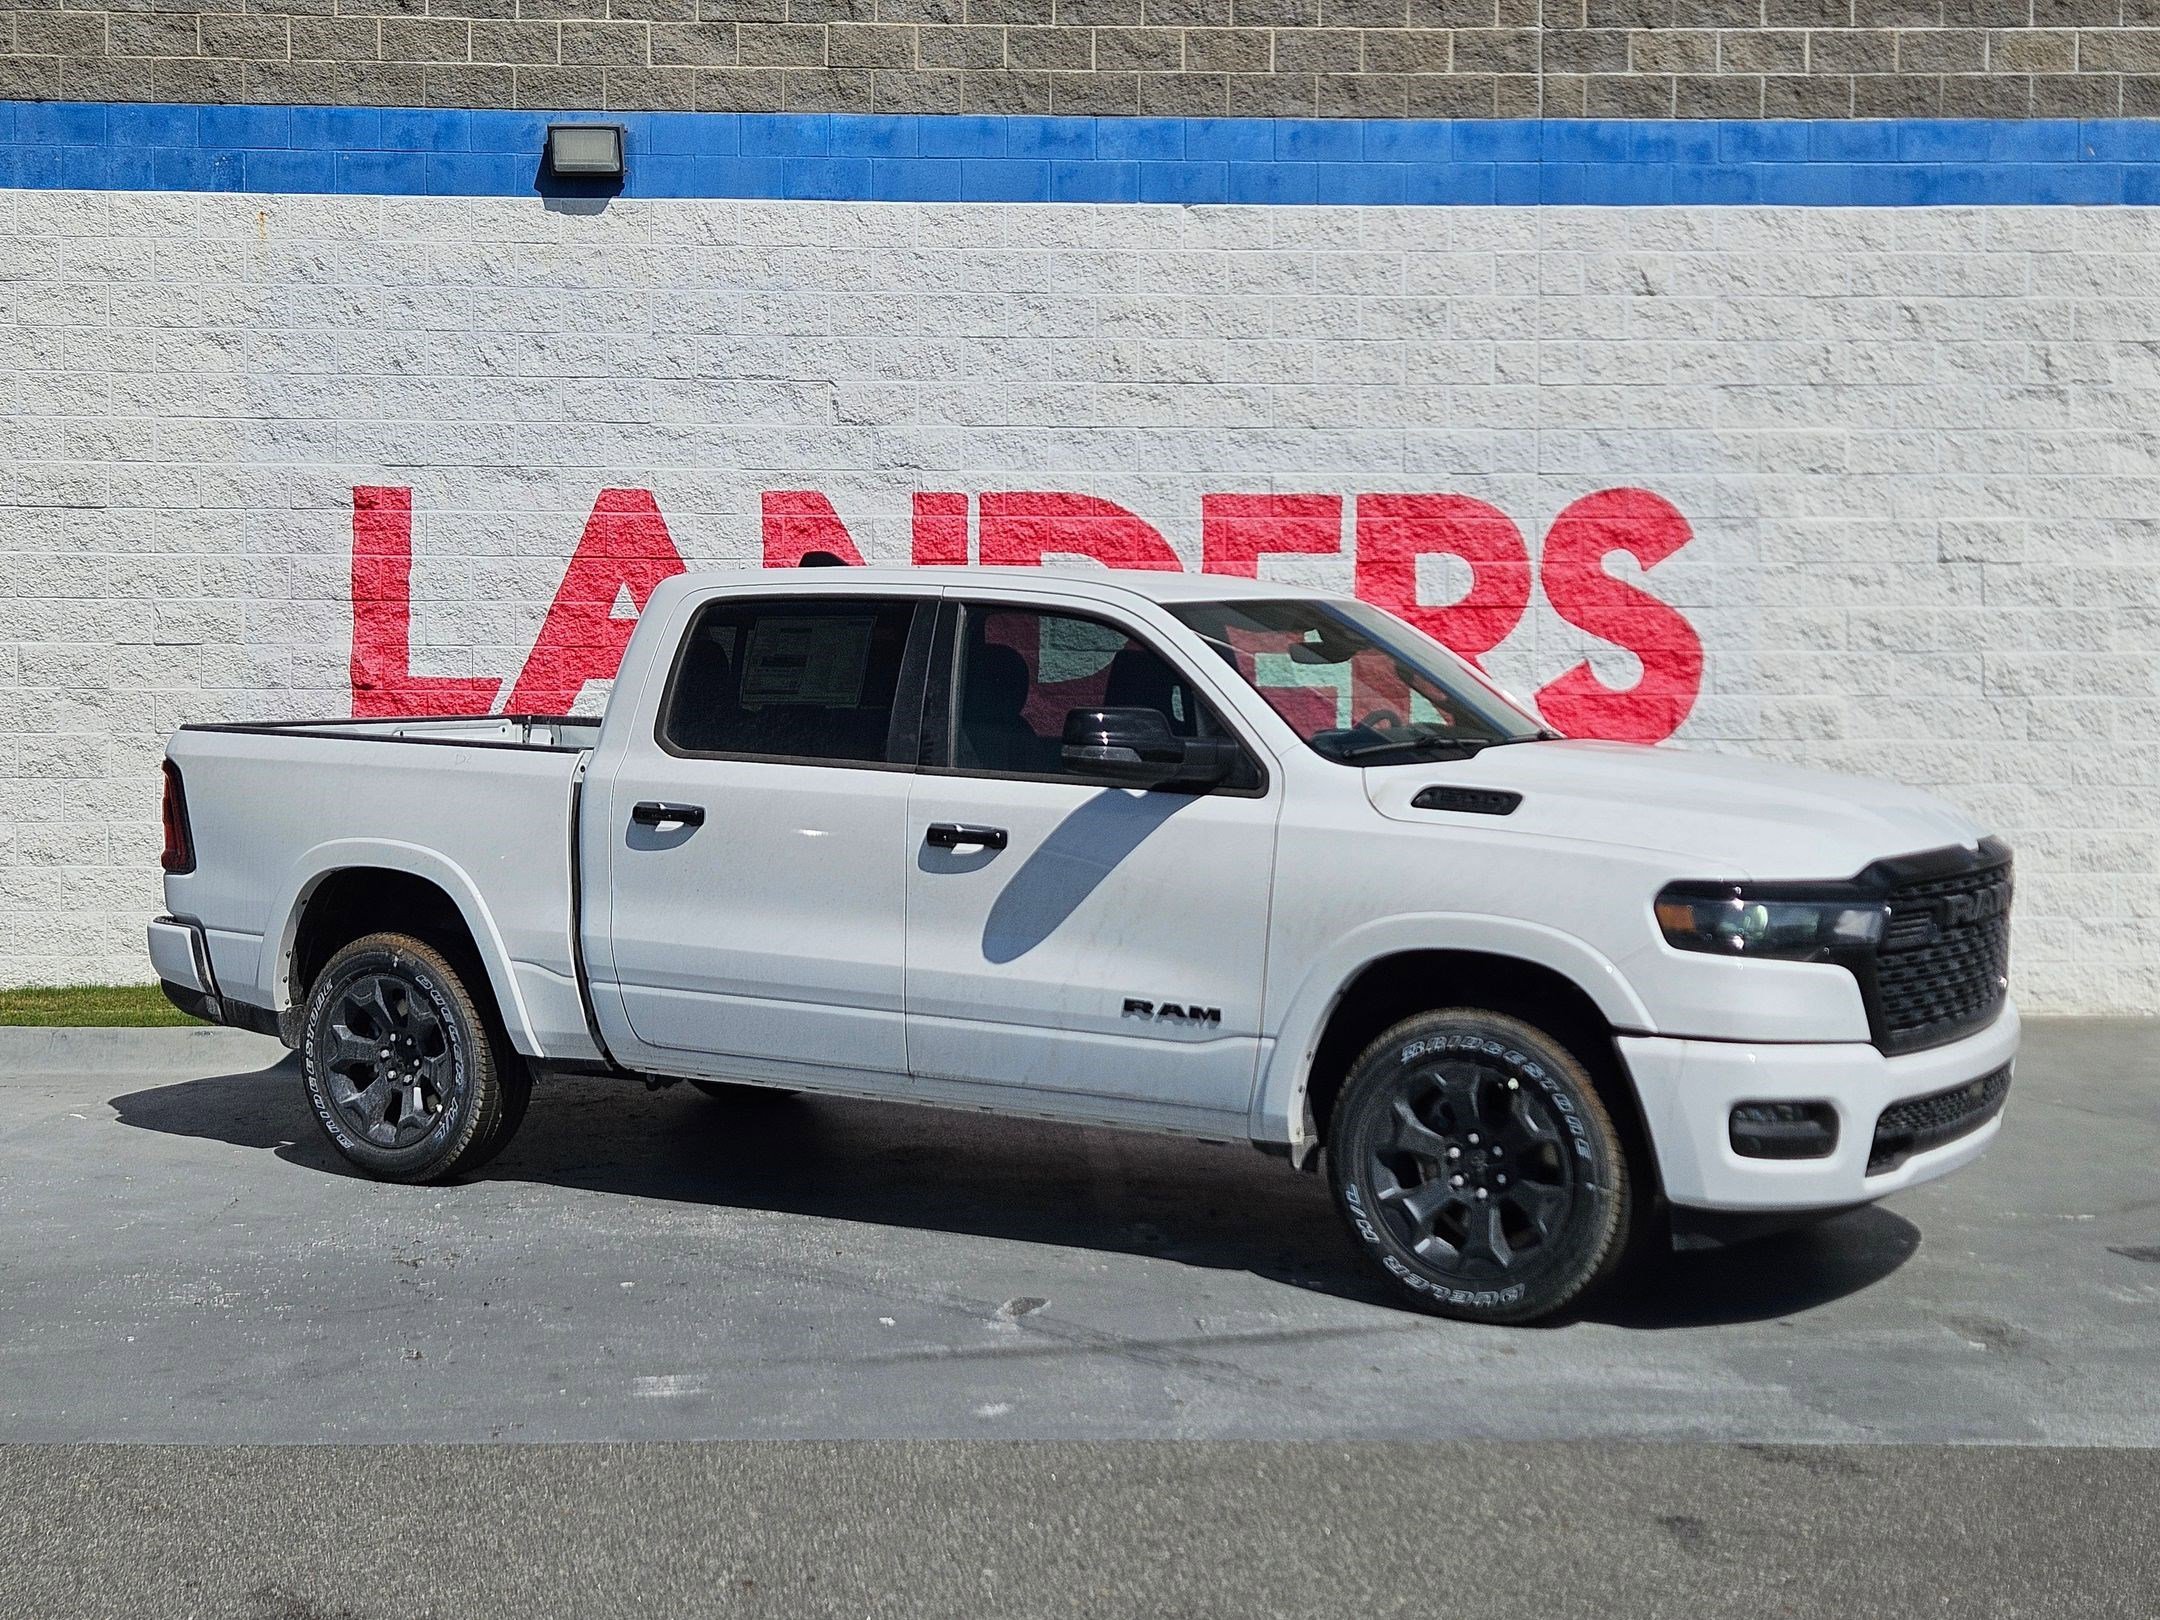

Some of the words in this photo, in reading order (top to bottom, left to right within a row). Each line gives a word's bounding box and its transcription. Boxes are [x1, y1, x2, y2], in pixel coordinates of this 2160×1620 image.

[305, 977, 355, 1149] BRIDGESTONE
[415, 974, 464, 1087] DUELER
[1123, 997, 1221, 1022] RAM
[1401, 1035, 1592, 1161] BRIDGESTONE
[1383, 1254, 1525, 1307] DUELER
